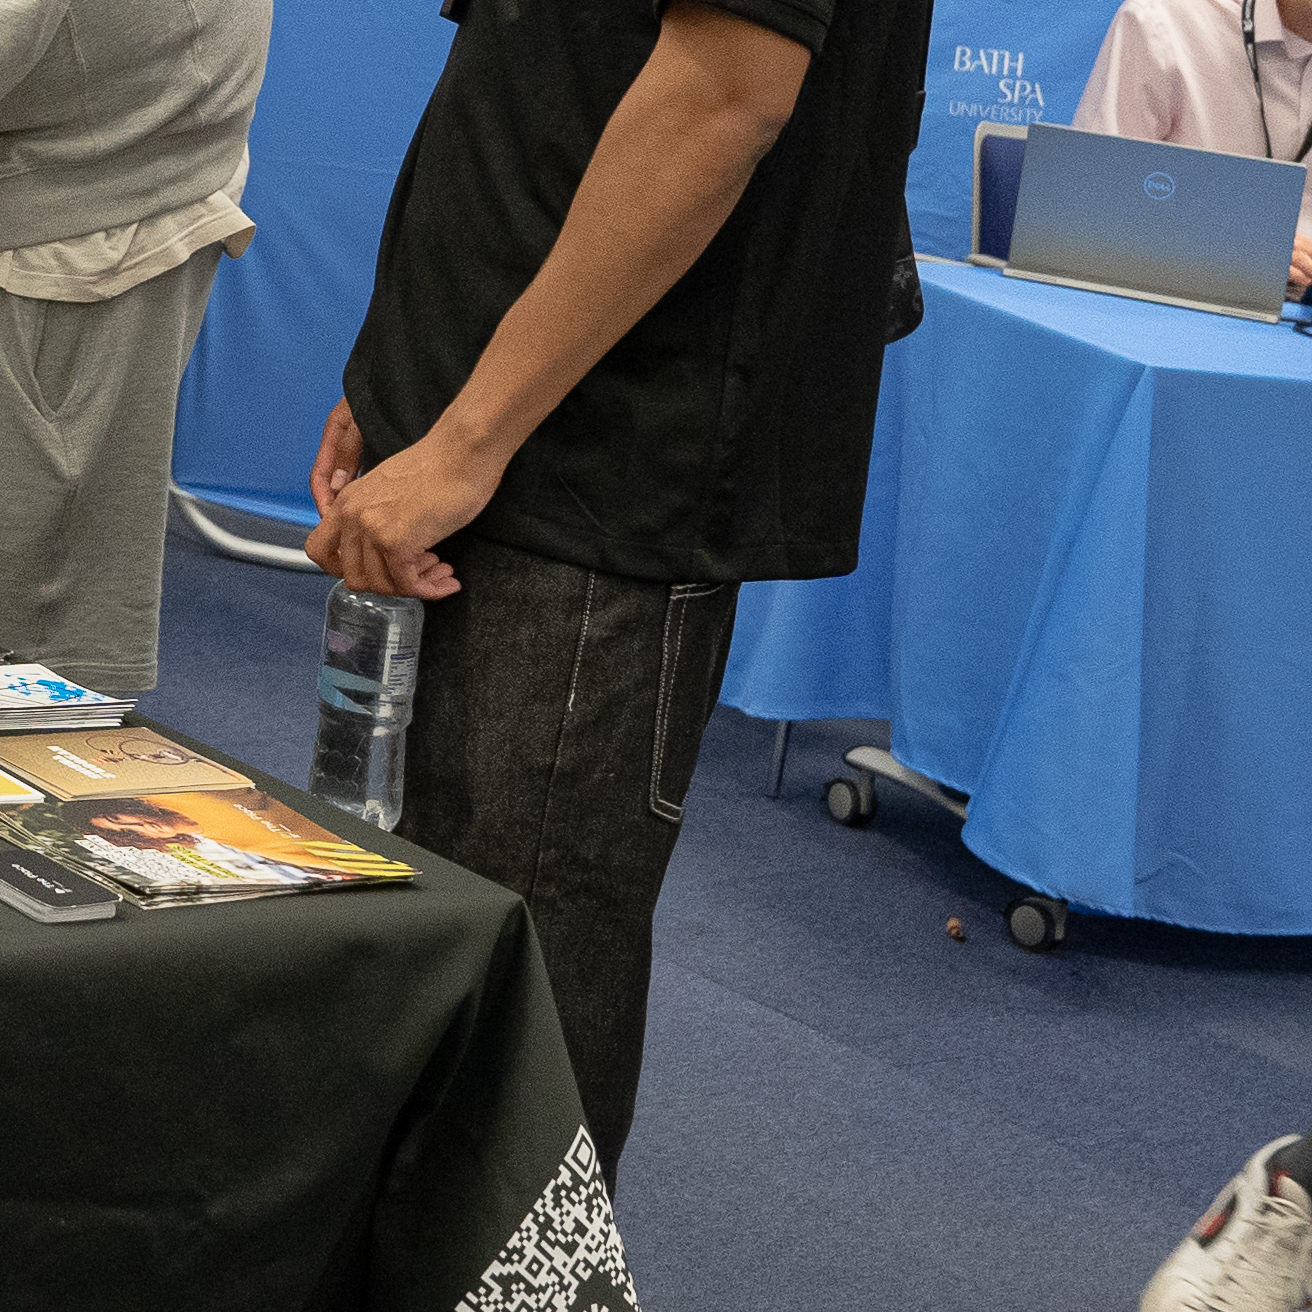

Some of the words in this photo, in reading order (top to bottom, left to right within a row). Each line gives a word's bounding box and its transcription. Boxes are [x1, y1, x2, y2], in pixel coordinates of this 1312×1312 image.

[953, 46, 1025, 77] BATH
[997, 78, 1045, 108] SPA
[949, 101, 1045, 124] UNIVERSITY
